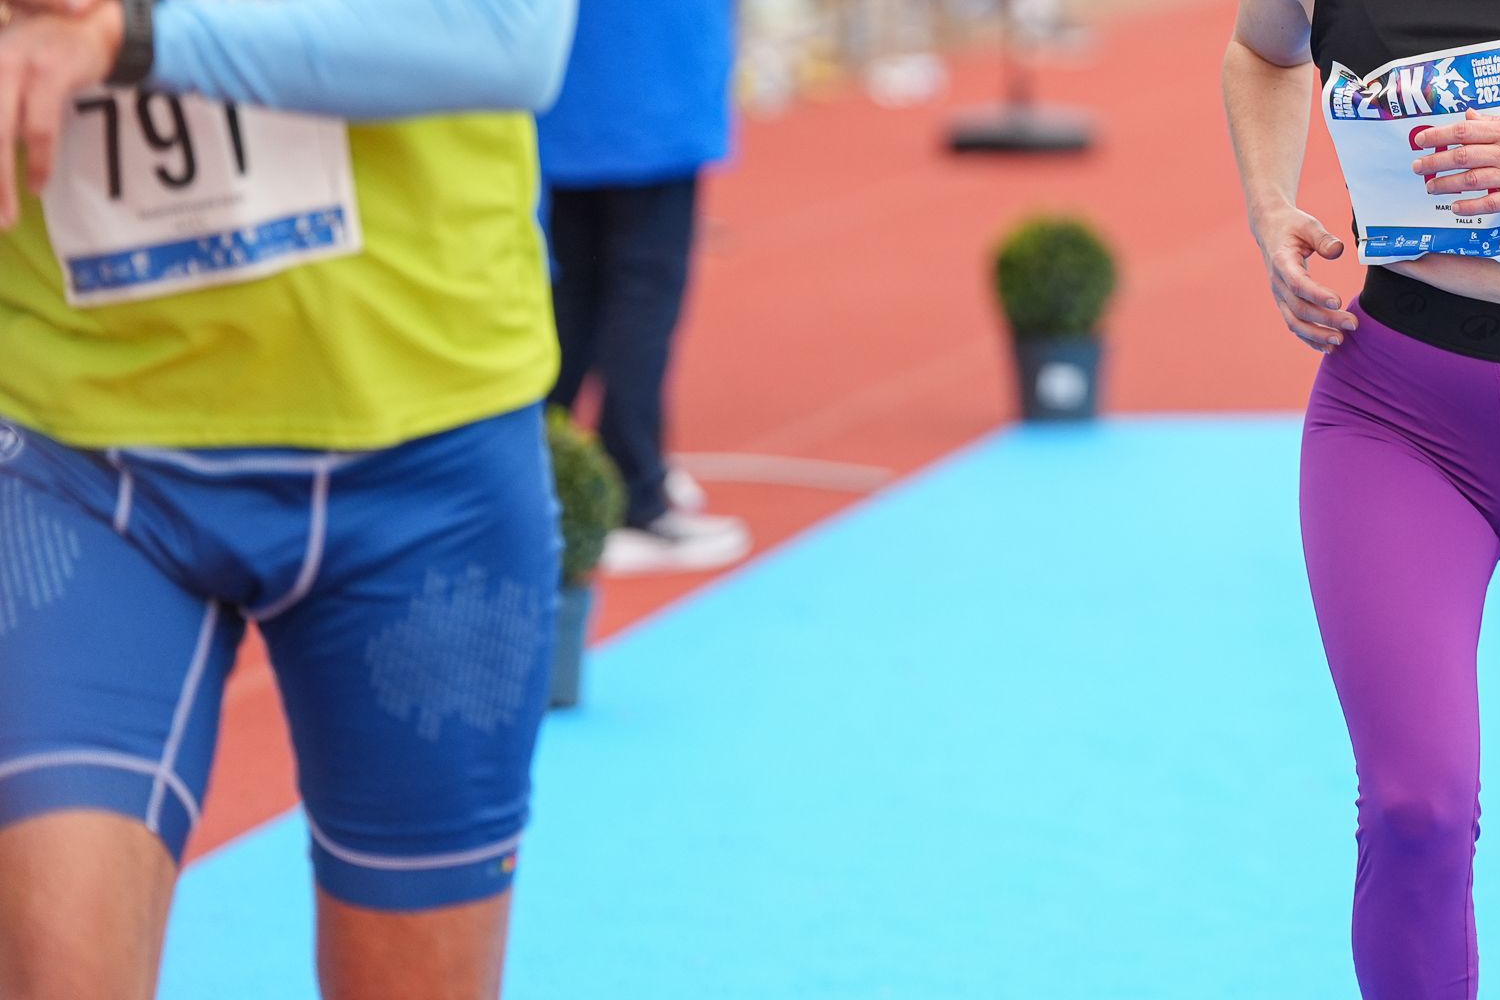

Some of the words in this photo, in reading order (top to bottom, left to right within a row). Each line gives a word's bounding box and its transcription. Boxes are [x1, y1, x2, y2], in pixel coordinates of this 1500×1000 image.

[1471, 56, 1493, 67] Ciudad
[1333, 86, 1346, 118] MEDIA
[1477, 217, 1482, 225] S
